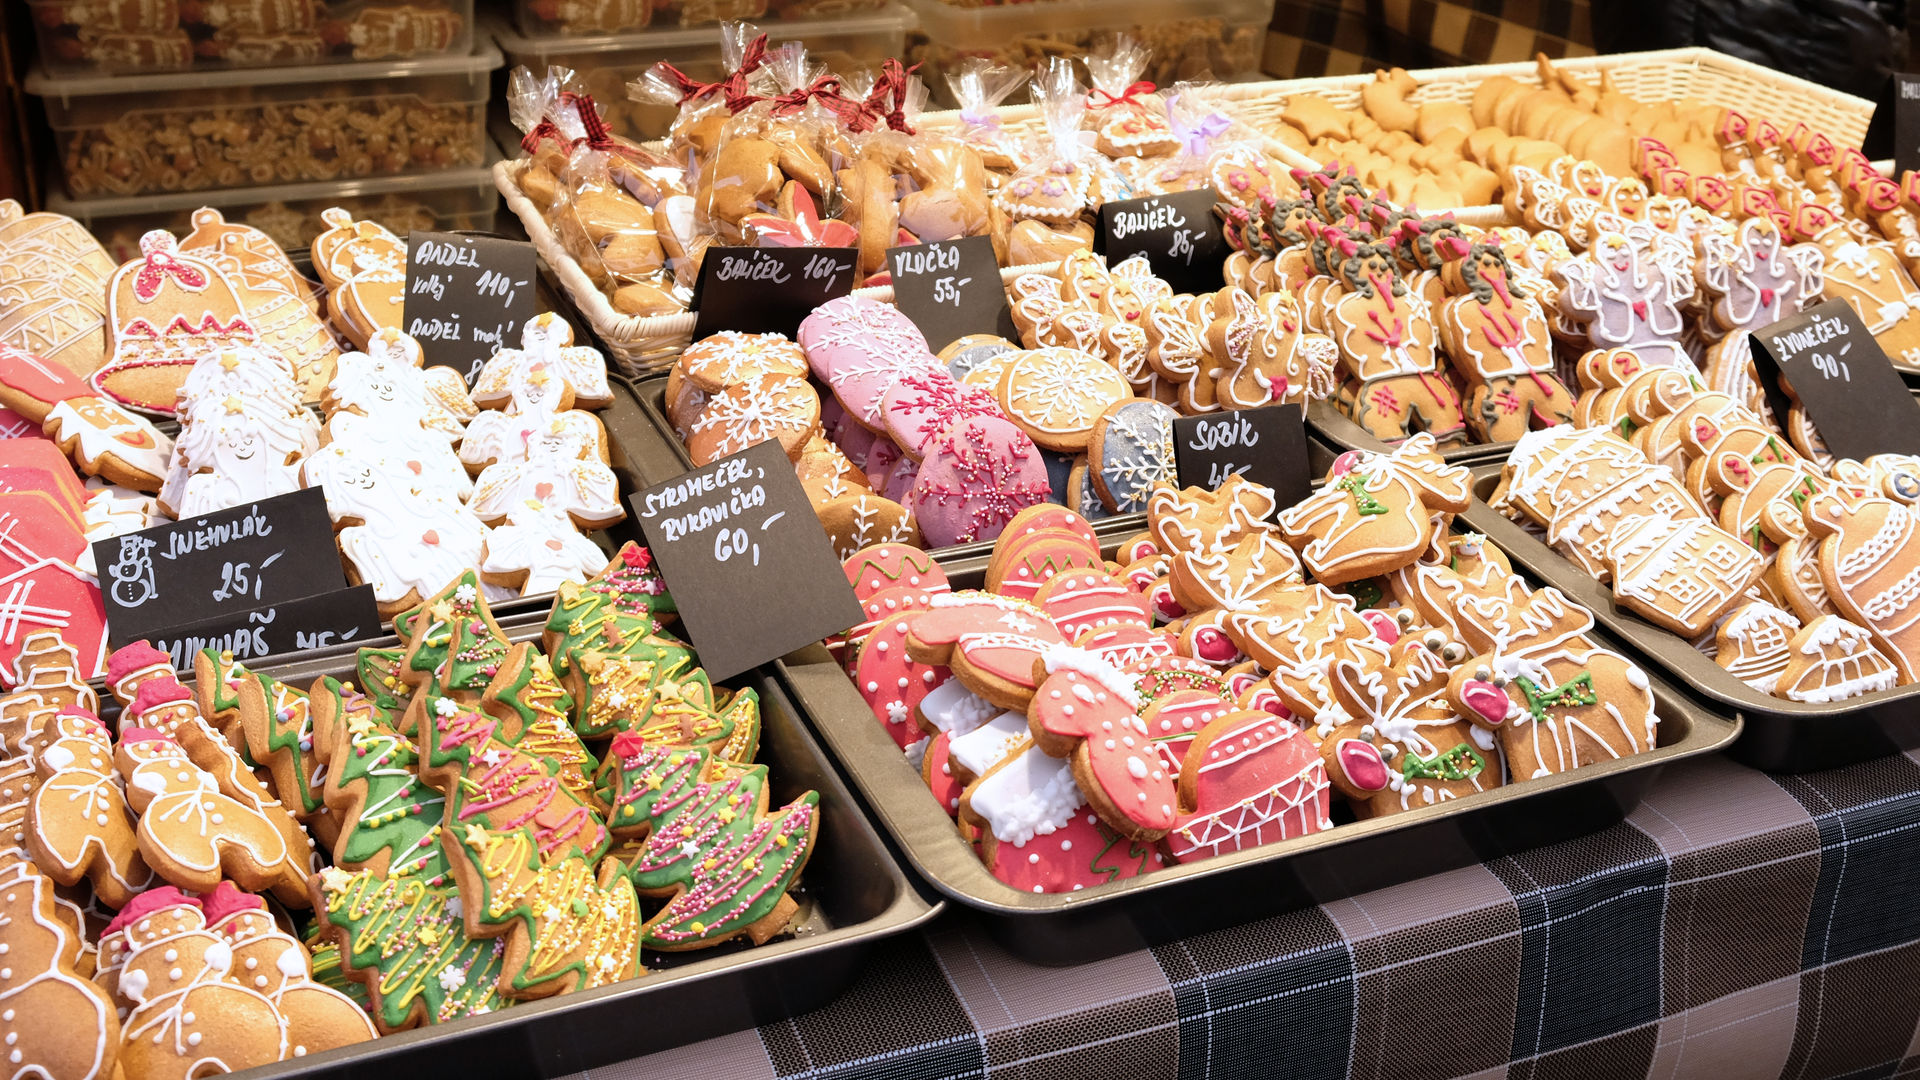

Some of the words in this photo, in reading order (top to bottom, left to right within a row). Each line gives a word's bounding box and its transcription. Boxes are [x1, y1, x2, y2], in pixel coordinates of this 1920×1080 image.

[1112, 199, 1186, 240] BALÍČEK
[716, 250, 792, 283] BALÍČEK
[804, 253, 852, 293] 160,-
[895, 242, 960, 277] VLOČKA
[475, 270, 529, 309] 110,-
[933, 276, 973, 307] 55,-
[1811, 342, 1852, 383] 90,-
[160, 504, 273, 560] SNĚHULÁK
[714, 510, 786, 567] 60,-
[212, 549, 286, 602] 25,-
